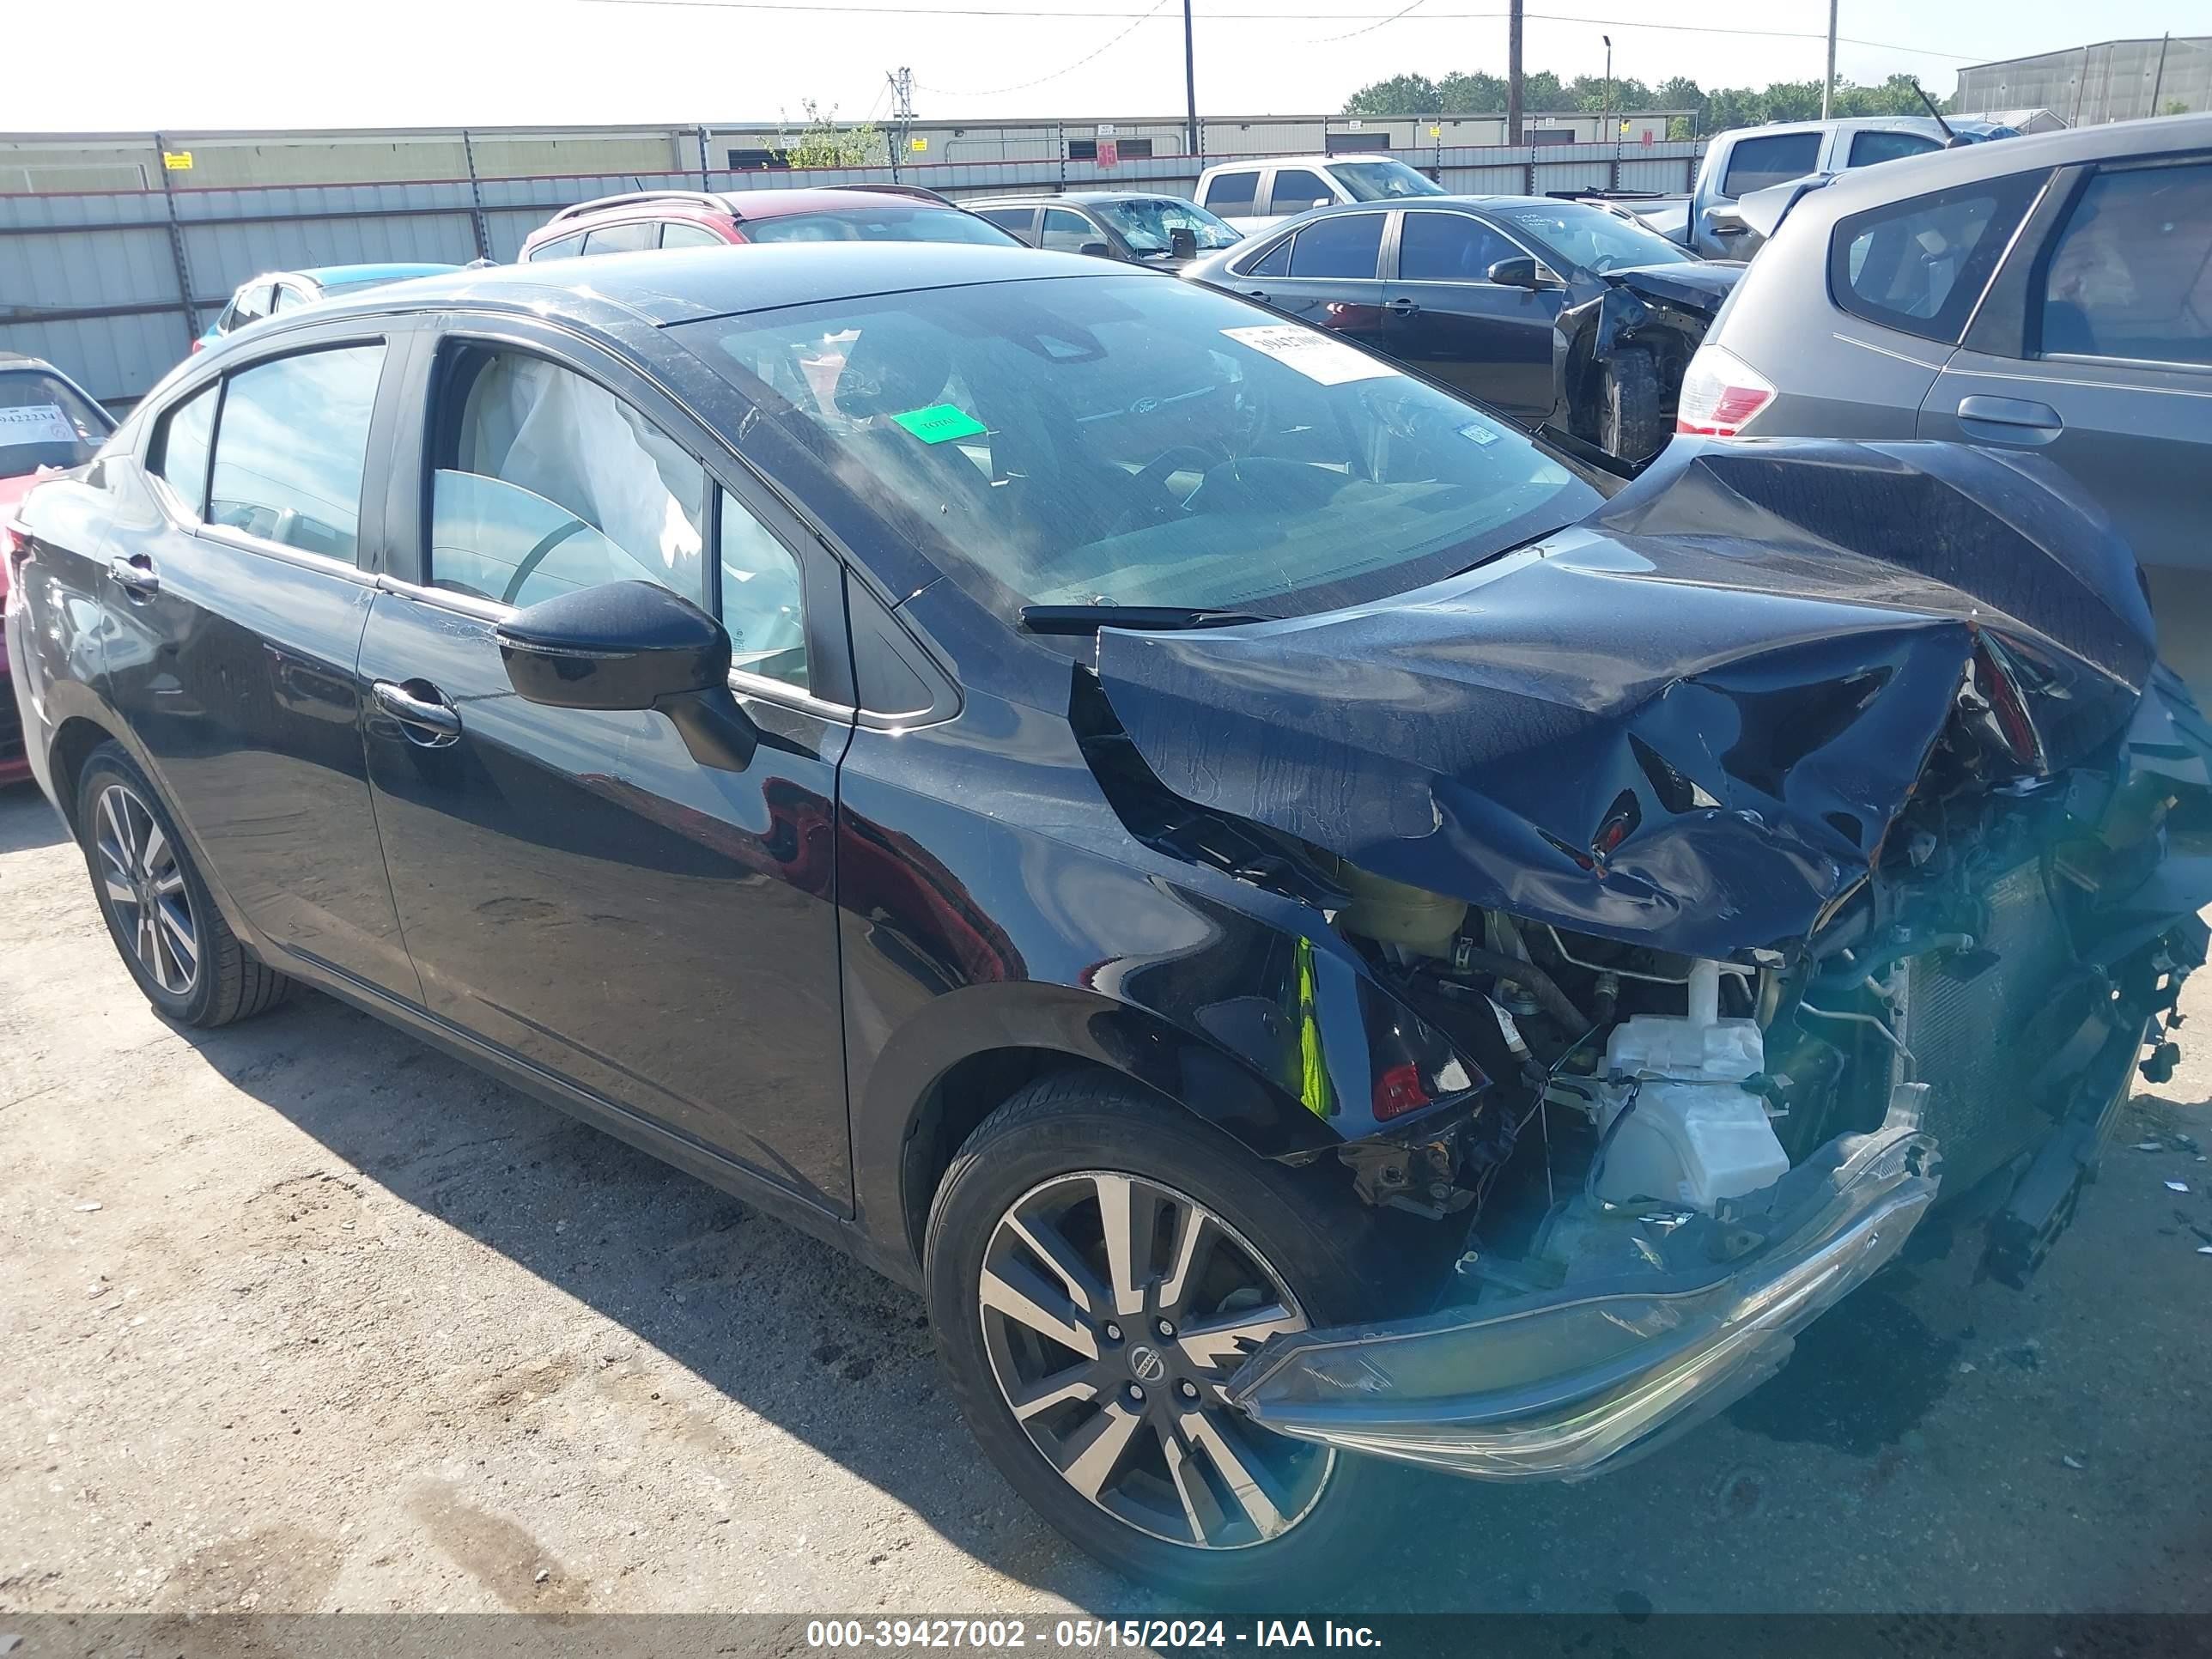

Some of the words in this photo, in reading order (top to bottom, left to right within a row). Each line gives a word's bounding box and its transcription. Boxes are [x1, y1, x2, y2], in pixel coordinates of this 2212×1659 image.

[1098, 144, 1116, 165] 35
[921, 418, 961, 429] TOTAL
[1137, 1353, 1156, 1376] NISSAN
